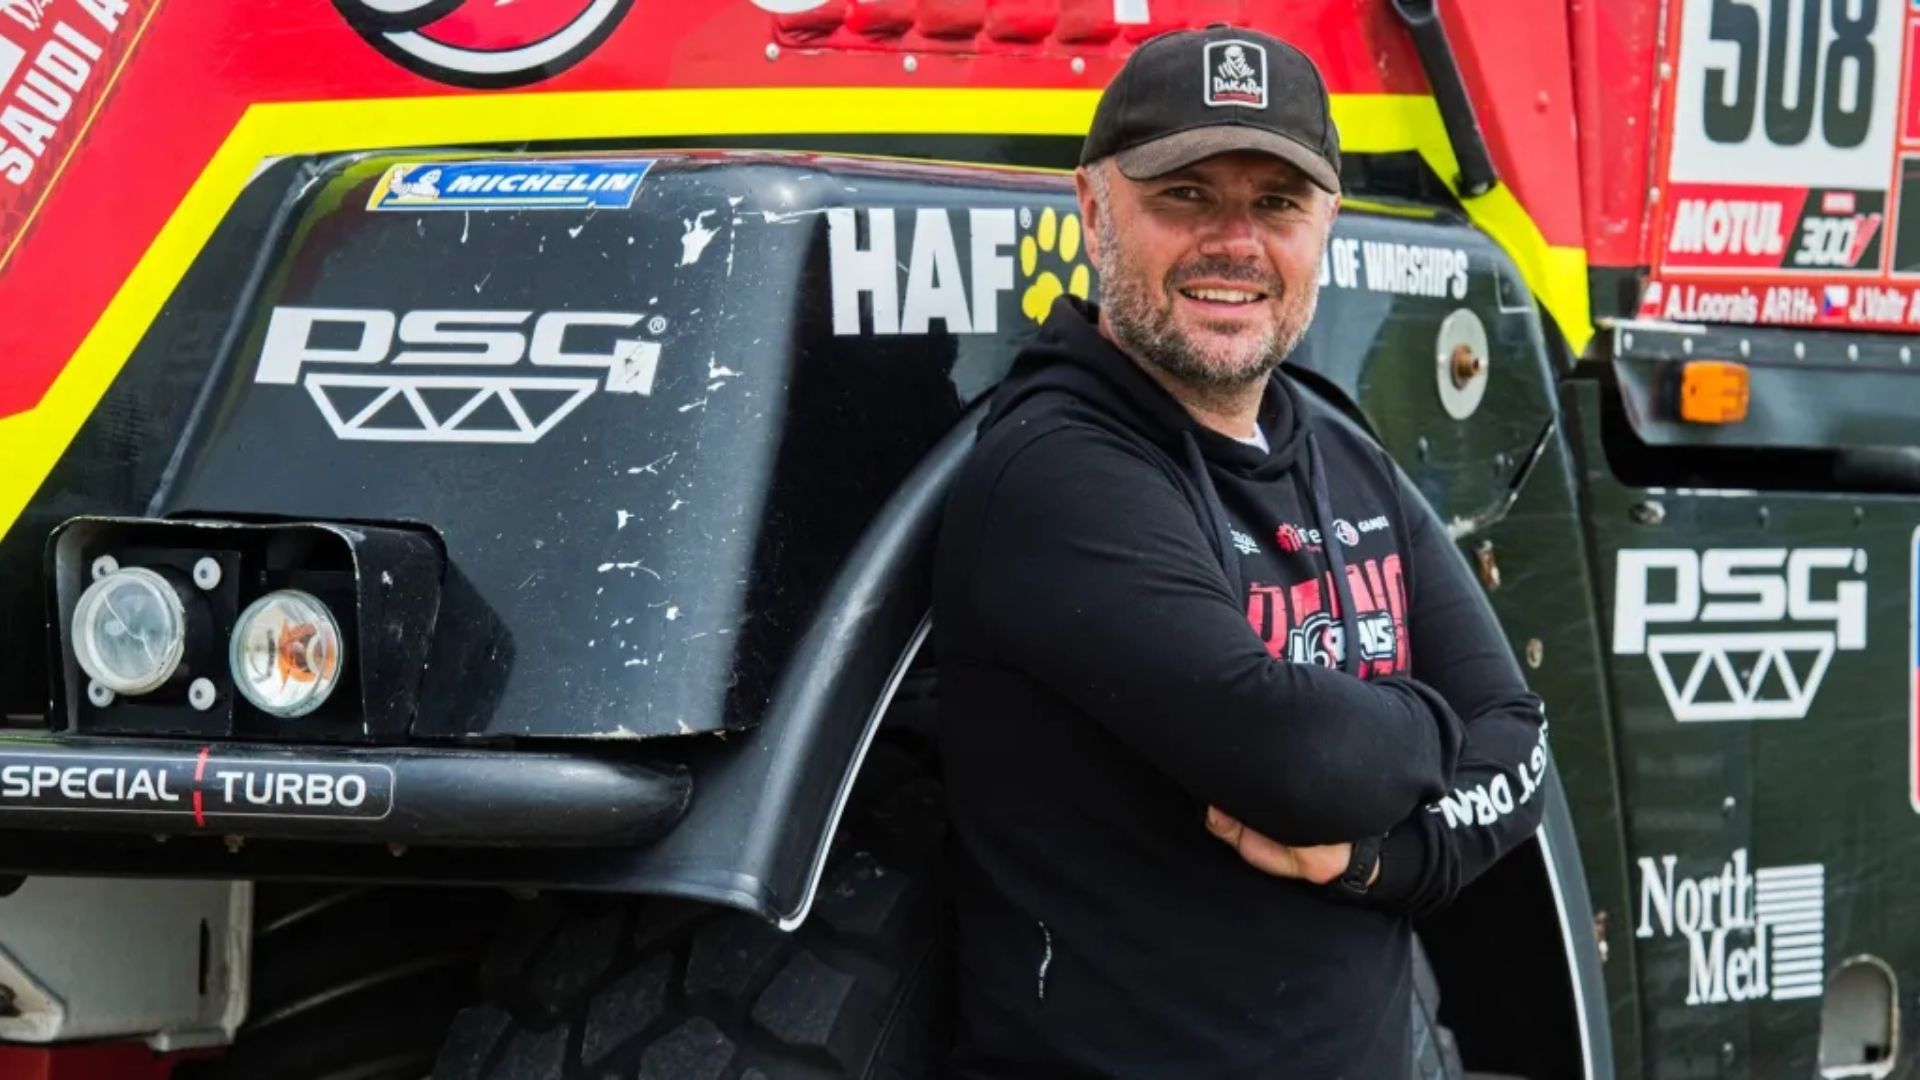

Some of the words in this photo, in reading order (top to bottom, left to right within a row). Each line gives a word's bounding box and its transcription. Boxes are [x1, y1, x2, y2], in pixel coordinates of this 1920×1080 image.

[0, 21, 103, 185] SAUDI
[1703, 0, 1878, 149] 508
[446, 173, 639, 192] MICHELIN
[828, 206, 1015, 335] HAF
[1331, 237, 1360, 288] OF
[1362, 240, 1469, 300] WARSHIPS
[1669, 199, 1785, 255] MOTUL
[1795, 213, 1882, 267] 300V
[2, 765, 179, 801] SPECIAL
[216, 771, 366, 807] TURBO
[1637, 849, 1755, 938] North
[1686, 922, 1769, 1006] Med
